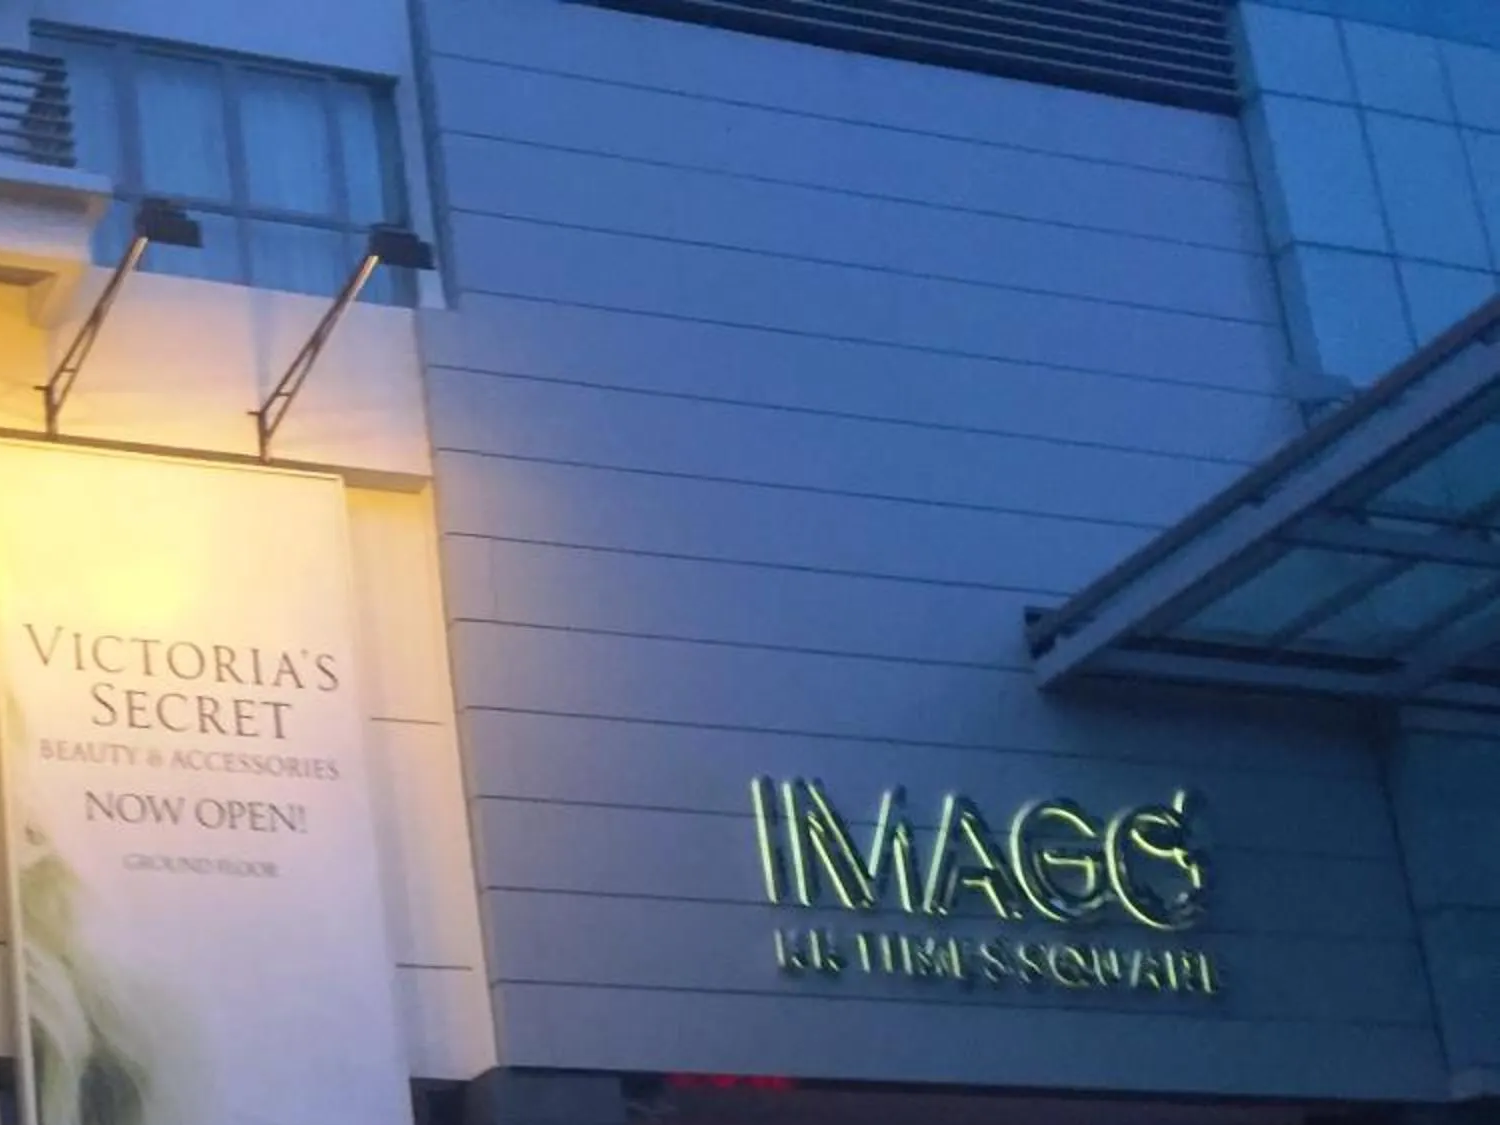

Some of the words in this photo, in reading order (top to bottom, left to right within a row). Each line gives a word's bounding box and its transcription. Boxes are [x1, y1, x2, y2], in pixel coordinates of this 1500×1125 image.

[22, 623, 339, 692] VICTORIA'S
[90, 682, 292, 739] SECRET
[40, 738, 138, 767] BEAUTY
[146, 746, 164, 768] &
[171, 750, 340, 781] ACCESSORIES
[85, 790, 185, 826] NOW
[195, 798, 308, 834] OPEN!
